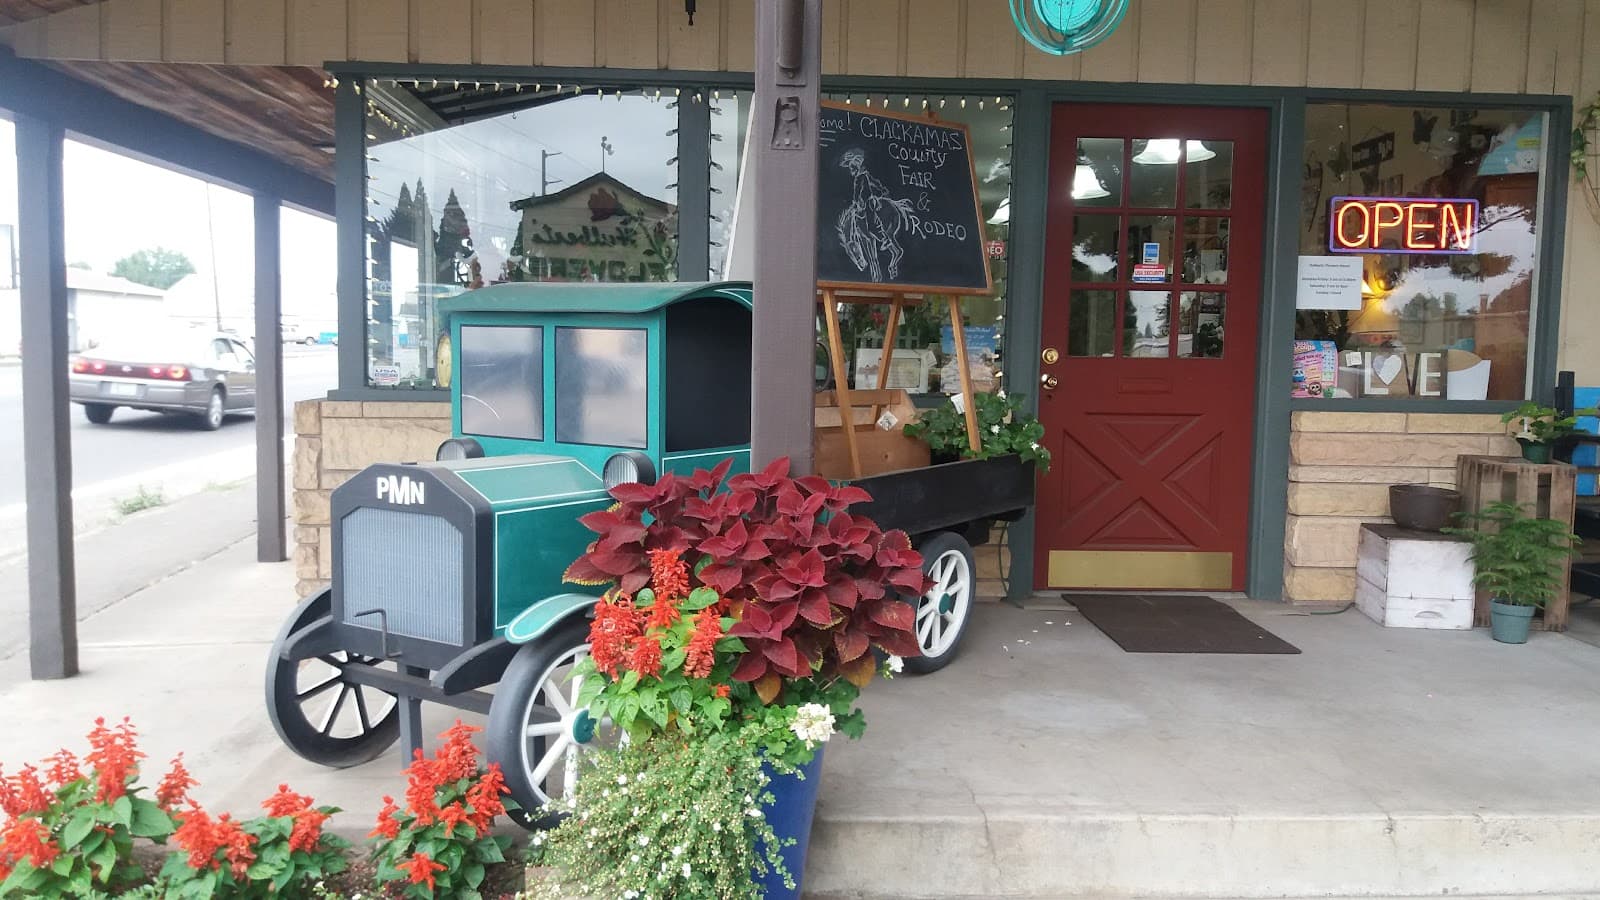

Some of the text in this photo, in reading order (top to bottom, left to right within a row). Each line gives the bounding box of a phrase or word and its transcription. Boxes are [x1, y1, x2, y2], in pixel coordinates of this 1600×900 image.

[860, 116, 963, 150] CLACKAMAS
[898, 164, 936, 190] FAIR
[911, 215, 967, 241] RODEO
[1337, 201, 1472, 250] OPEN
[376, 475, 425, 506] PMN
